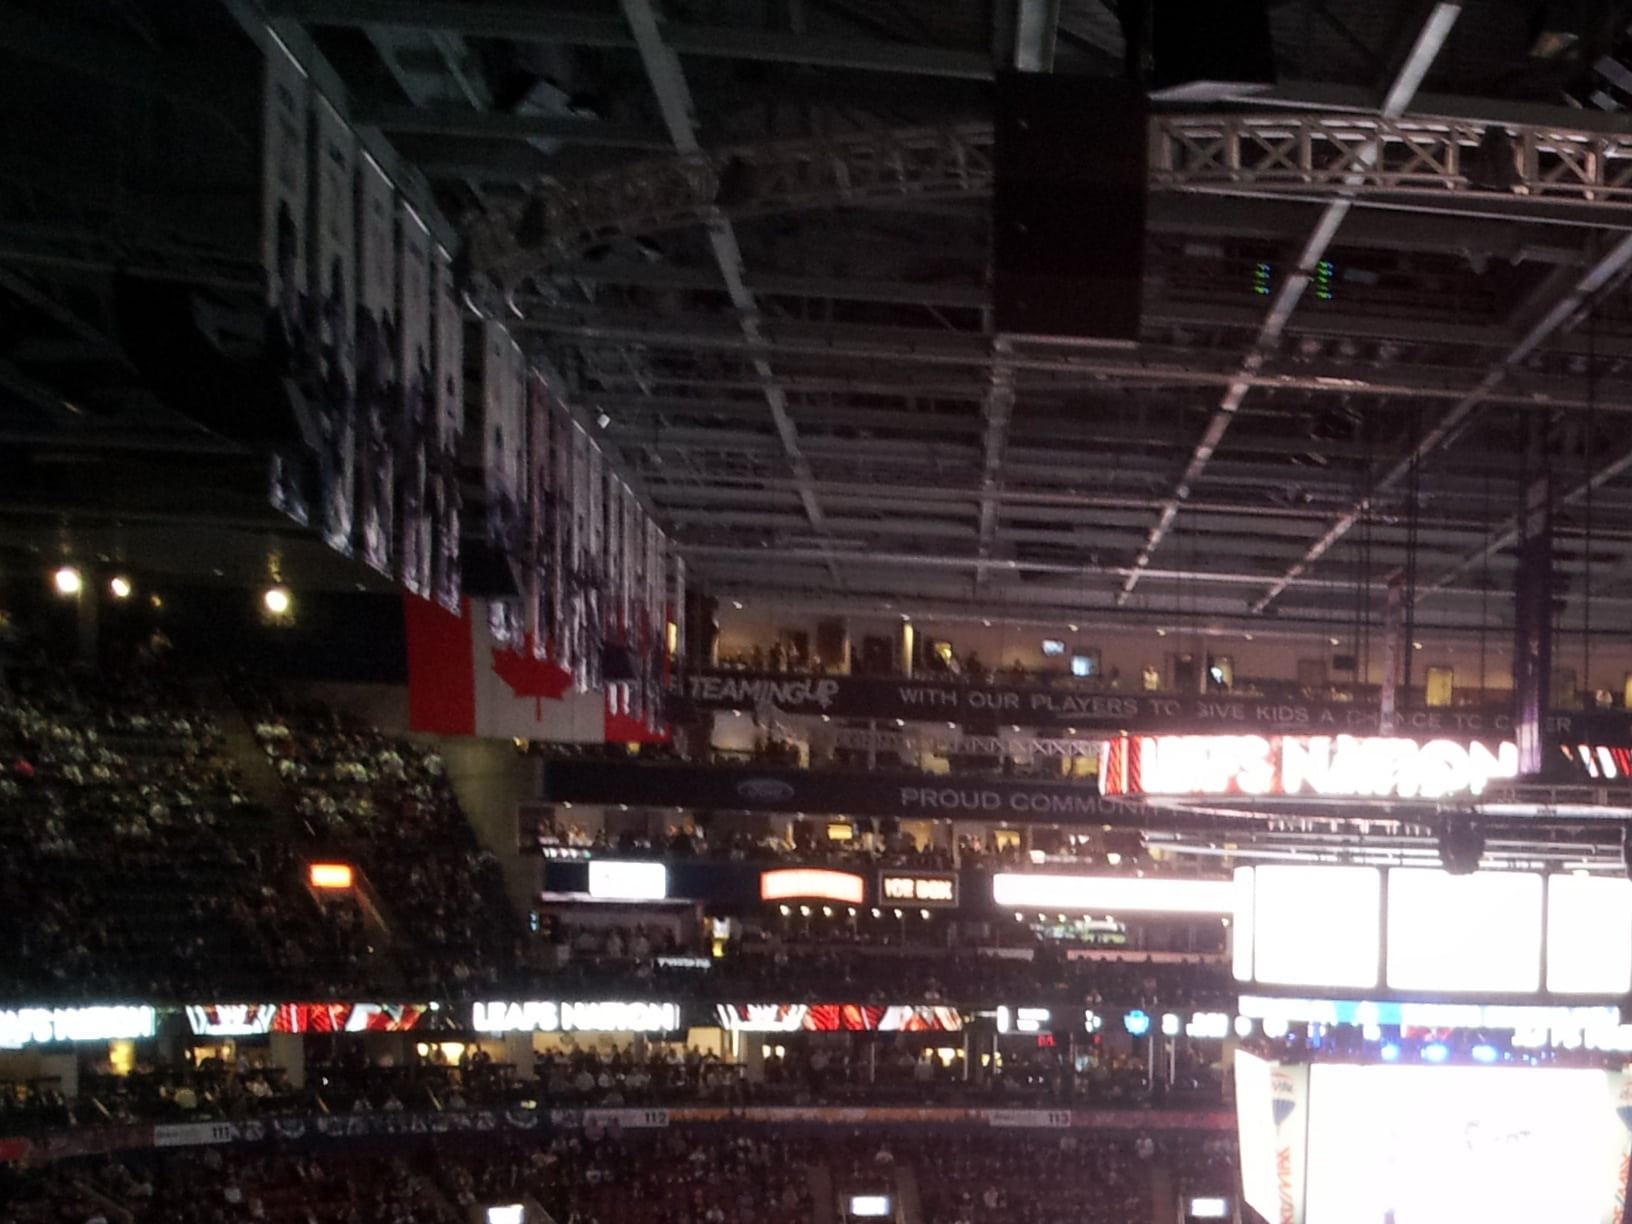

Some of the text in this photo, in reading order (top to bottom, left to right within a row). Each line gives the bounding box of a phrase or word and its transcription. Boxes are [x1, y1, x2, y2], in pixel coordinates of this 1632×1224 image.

[900, 687, 957, 708] WITH
[969, 689, 1020, 709] OUR
[1031, 692, 1139, 716] PLAYERS
[1256, 704, 1309, 722] KIDS
[901, 788, 1000, 811] PROUD
